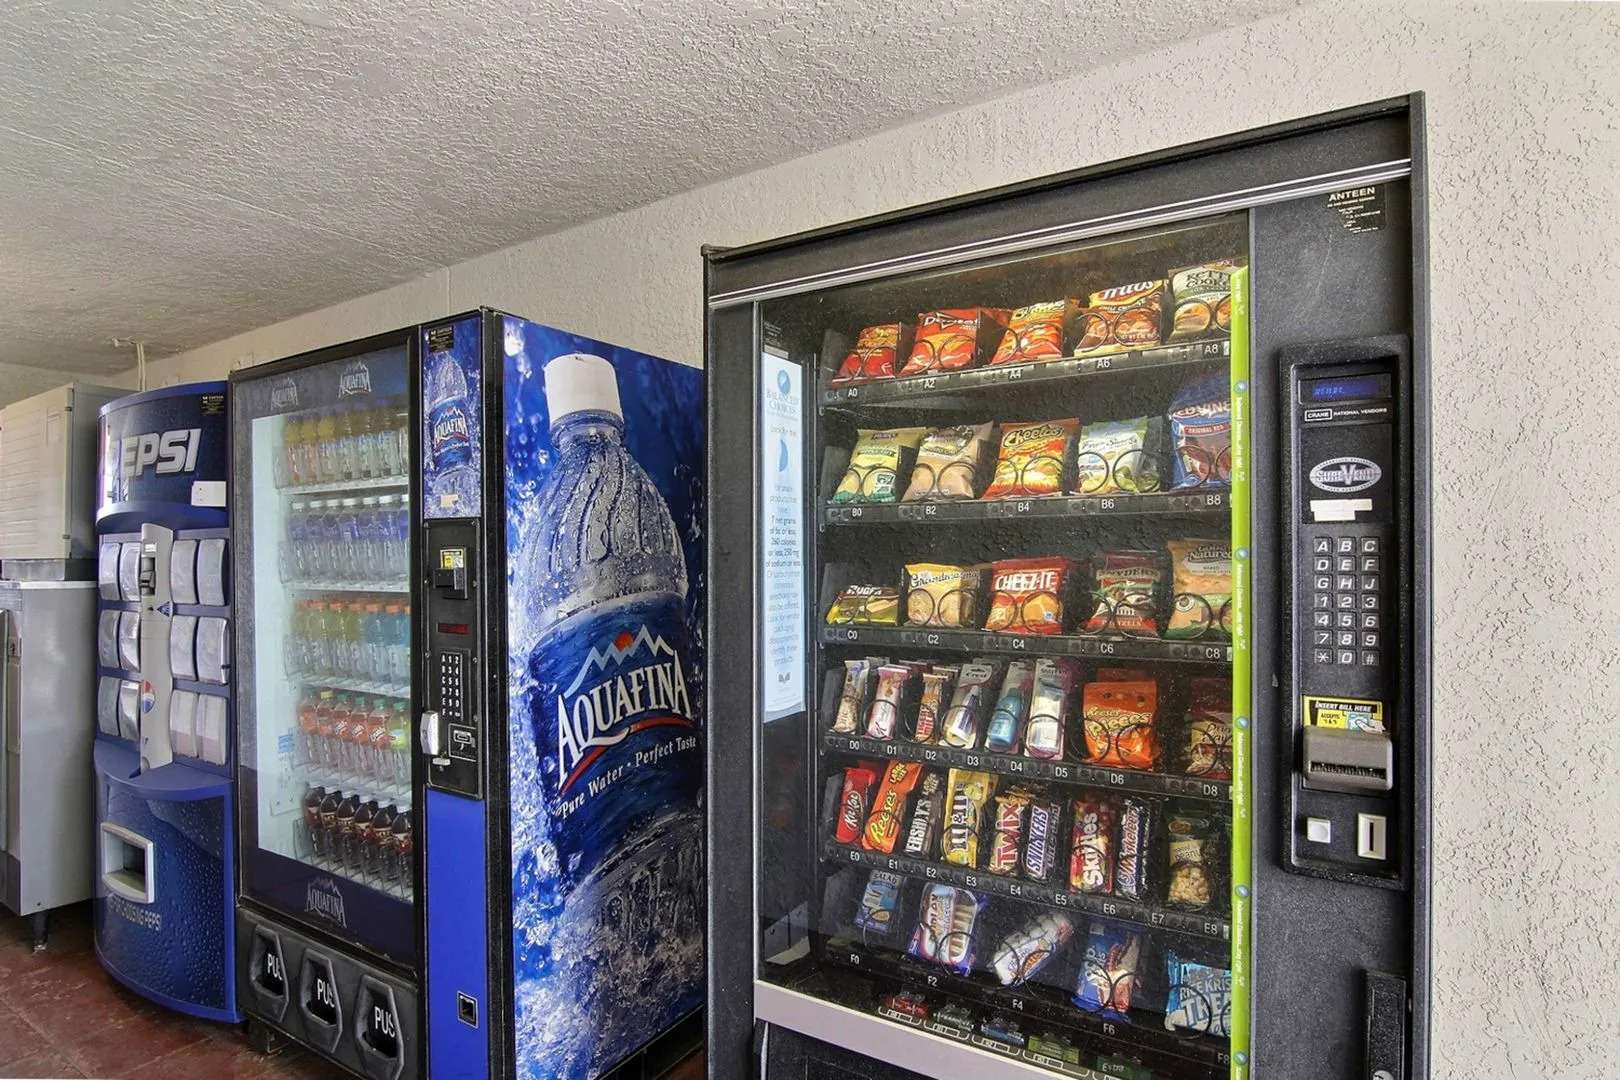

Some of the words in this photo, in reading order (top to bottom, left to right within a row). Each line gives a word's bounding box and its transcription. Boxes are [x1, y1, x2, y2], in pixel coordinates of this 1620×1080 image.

[1204, 344, 1218, 354] A8
[1096, 360, 1110, 369] A6
[1009, 370, 1022, 379] A4
[924, 379, 935, 389] A2
[848, 388, 858, 397] A0
[1002, 424, 1065, 448] Cheetos
[1101, 499, 1115, 509] B6
[1206, 494, 1221, 506] B8
[852, 507, 862, 517] B0
[925, 506, 936, 515] B2
[1017, 502, 1030, 512] B4
[1317, 541, 1328, 552] A
[1341, 541, 1352, 552] B
[1364, 541, 1376, 552] C
[1317, 560, 1328, 570] D
[1341, 560, 1352, 571] E
[1365, 560, 1375, 570] F
[1317, 578, 1329, 589] G
[1340, 578, 1353, 589] H
[1365, 578, 1375, 589] J
[1320, 596, 1328, 607] 1
[1341, 597, 1353, 608] 2
[1365, 597, 1376, 608] 3
[1318, 615, 1329, 626] 4
[1342, 615, 1352, 626] 5
[1365, 616, 1376, 627] 6
[847, 630, 858, 640] C0
[928, 634, 939, 645] C2
[1319, 633, 1329, 644] 7
[1342, 634, 1353, 645] 8
[1365, 635, 1376, 646] 9
[1012, 638, 1025, 649] C4
[1100, 643, 1114, 654] C6
[1205, 648, 1221, 659] C8
[1315, 701, 1338, 709] INSERT
[1339, 703, 1353, 711] BILL
[1354, 704, 1373, 712] HERE
[557, 649, 693, 791] AQUAFINA
[849, 740, 860, 751] D0
[887, 745, 897, 755] D1
[925, 750, 937, 761] D2
[967, 755, 979, 766] D3
[1010, 761, 1023, 772] D4
[562, 794, 586, 820] Pure
[587, 763, 624, 798] Water
[635, 740, 674, 768] Perfect
[675, 735, 697, 752] Taste
[1055, 767, 1068, 778] D5
[1110, 773, 1125, 785] D6
[1203, 784, 1218, 797] D8
[995, 801, 1021, 868] TWIX
[850, 851, 860, 861] E0
[888, 859, 898, 870] E1
[926, 867, 937, 878] E2
[966, 875, 977, 887] E3
[1010, 884, 1021, 896] E4
[1055, 894, 1067, 905] E5
[303, 887, 348, 929] AQUAFINA
[1103, 903, 1116, 915] E6
[1151, 912, 1165, 924] E7
[1204, 922, 1218, 934] E8
[850, 954, 860, 965] F0
[927, 975, 938, 987] F2
[1204, 978, 1232, 995] KRIS
[1012, 999, 1023, 1011] F4
[374, 1006, 396, 1038] PUS
[1103, 1023, 1116, 1035] F6
